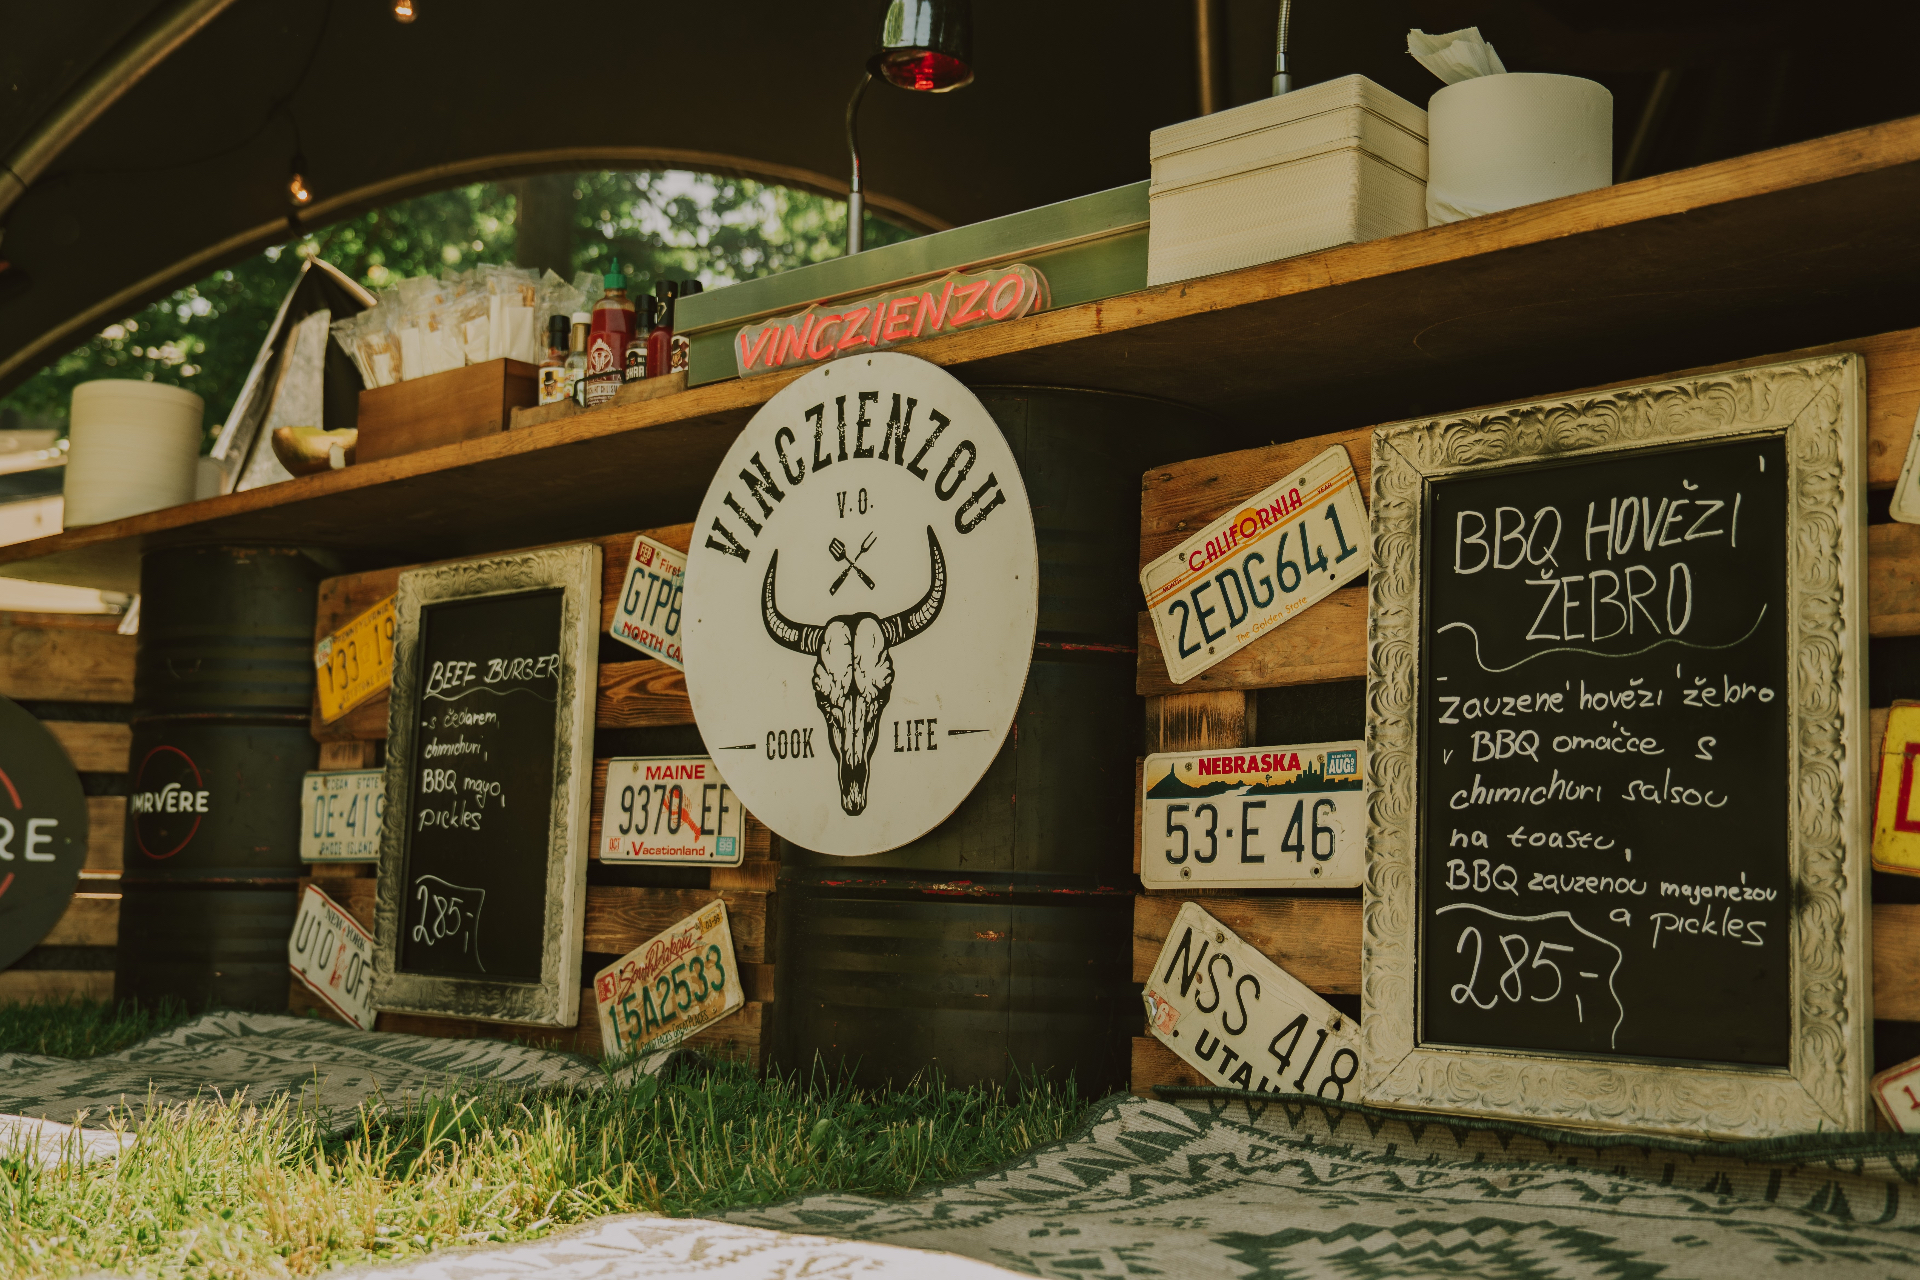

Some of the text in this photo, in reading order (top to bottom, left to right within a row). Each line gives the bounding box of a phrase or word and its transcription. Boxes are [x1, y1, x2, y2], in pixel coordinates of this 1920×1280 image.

[741, 273, 1025, 369] VINCZIENZO
[705, 390, 1007, 564] VINCZIENZOU
[1188, 487, 1303, 571] CALIFORNIA
[1454, 506, 1561, 574] BBQ
[659, 558, 682, 577] First
[1168, 503, 1358, 659] 2EDG641
[1236, 596, 1308, 644] The Golden State
[1525, 562, 1692, 642] ŽEBRO
[621, 621, 684, 664] NORTH CA
[484, 654, 559, 683] BURGER
[765, 718, 938, 760] COOK LIFE
[1471, 729, 1539, 762] BBQ
[356, 777, 380, 789] STATE
[422, 769, 458, 795] BBQ
[645, 764, 706, 781] MAINE
[1198, 752, 1302, 776] NEBRASKA
[1329, 758, 1350, 774] AUG
[619, 783, 733, 835] 9370 EF
[1450, 769, 1601, 810] chimichuri
[418, 800, 482, 832] pickles
[1281, 798, 1337, 863] 46
[347, 841, 374, 855] ISLAND
[632, 842, 706, 856] Vacationland
[1450, 829, 1489, 849] na
[1446, 858, 1519, 896] BBQ
[325, 907, 367, 952] NEW YORK
[1650, 904, 1767, 949] pickles
[609, 944, 726, 1050] 15A2533
[1163, 927, 1359, 1101] NSS 418
